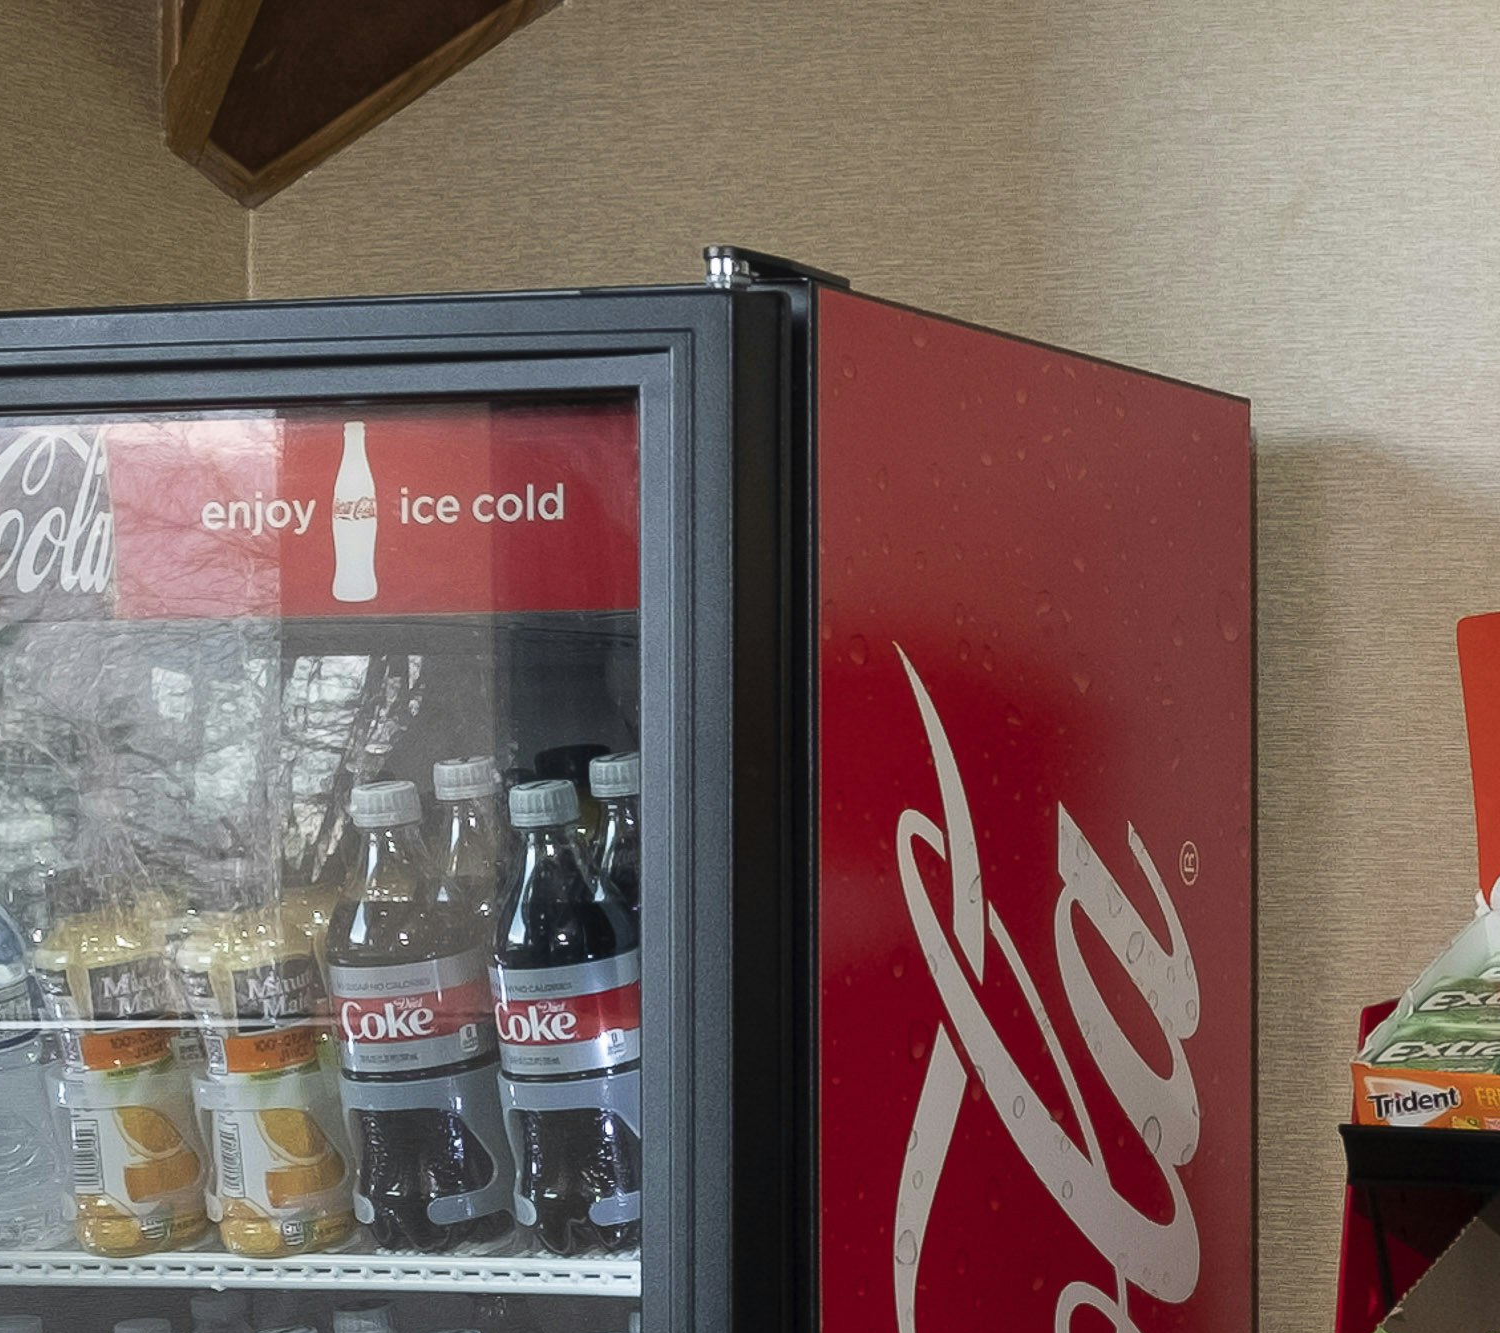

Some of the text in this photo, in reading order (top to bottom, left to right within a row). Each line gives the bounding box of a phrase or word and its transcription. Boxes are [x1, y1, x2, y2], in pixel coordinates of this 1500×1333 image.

[202, 491, 316, 535] enjoy
[401, 487, 460, 525] ice
[472, 483, 564, 525] cold
[342, 1000, 434, 1040] Coke
[495, 1002, 577, 1041] Coke
[1368, 1086, 1459, 1119] Trident
